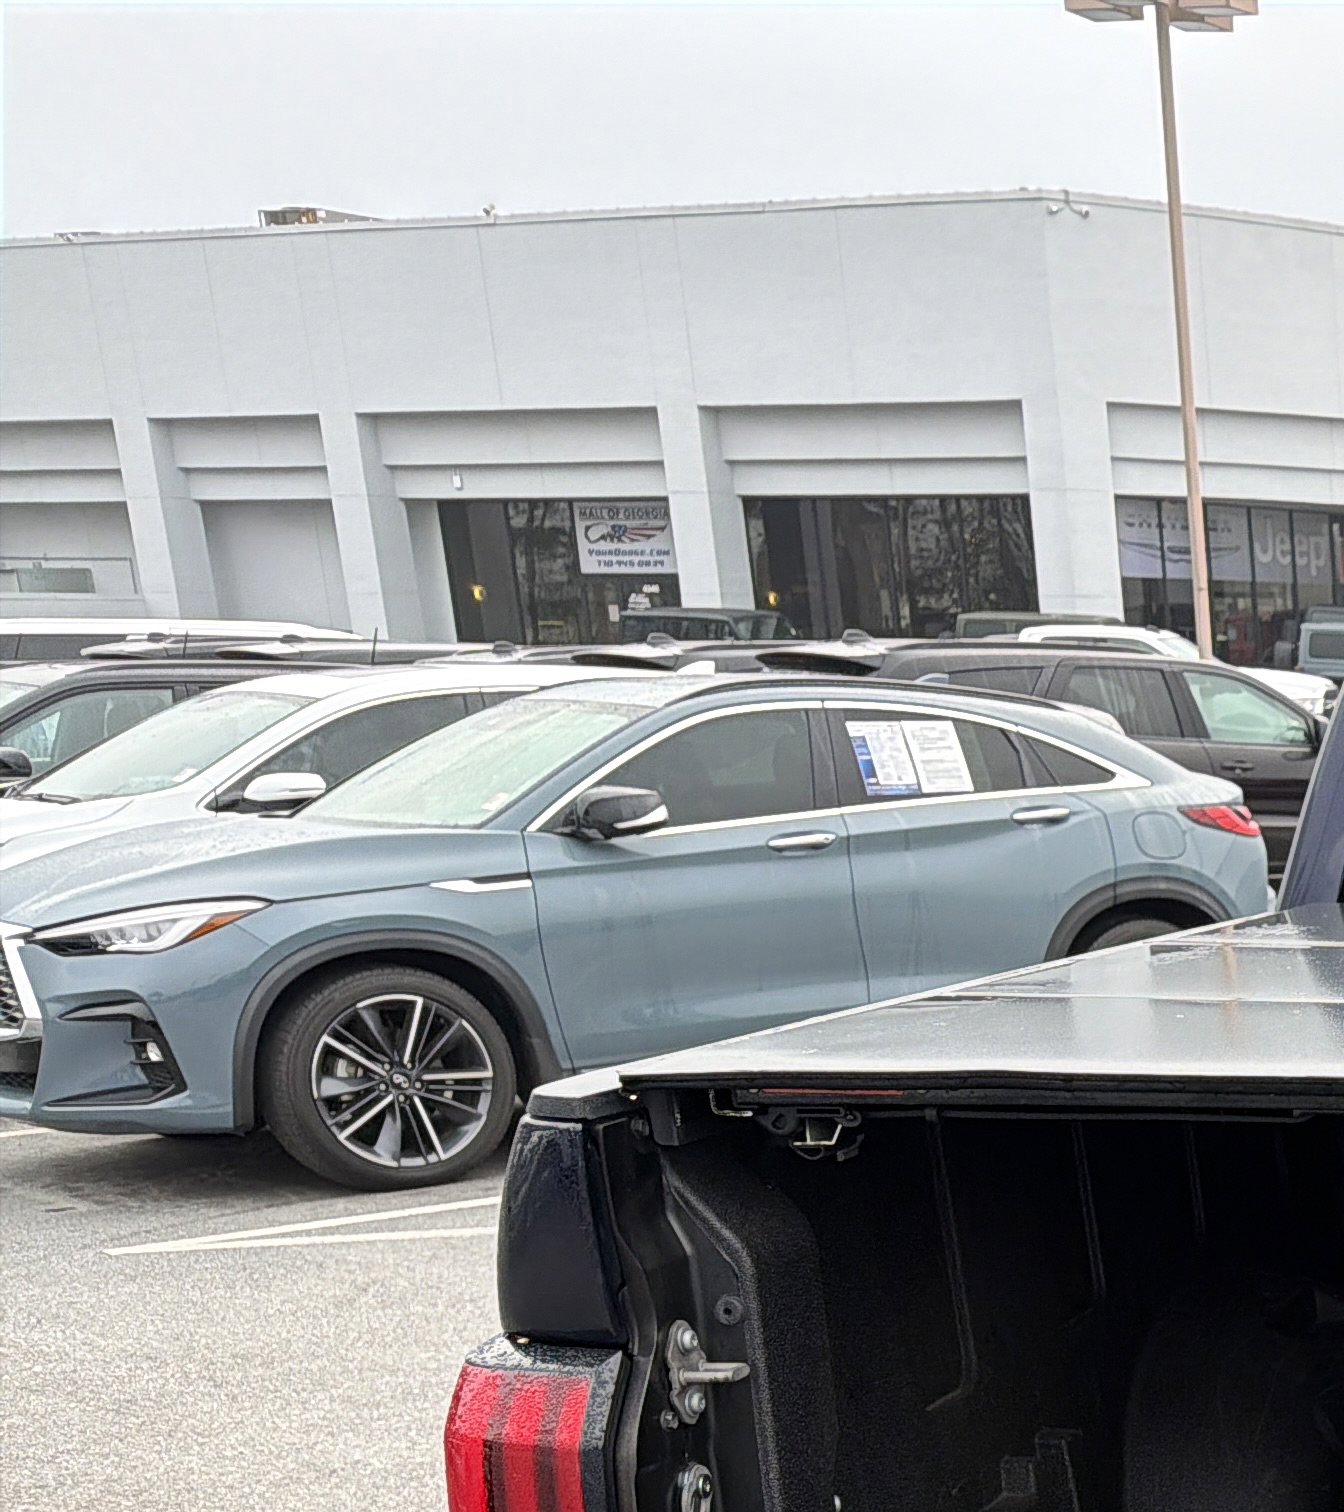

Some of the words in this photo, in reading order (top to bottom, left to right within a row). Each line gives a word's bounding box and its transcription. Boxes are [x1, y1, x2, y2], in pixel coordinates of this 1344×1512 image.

[579, 507, 605, 520] MALL
[607, 507, 620, 520] OF
[623, 507, 670, 520] GEORGIA
[1254, 515, 1330, 577] Jeep
